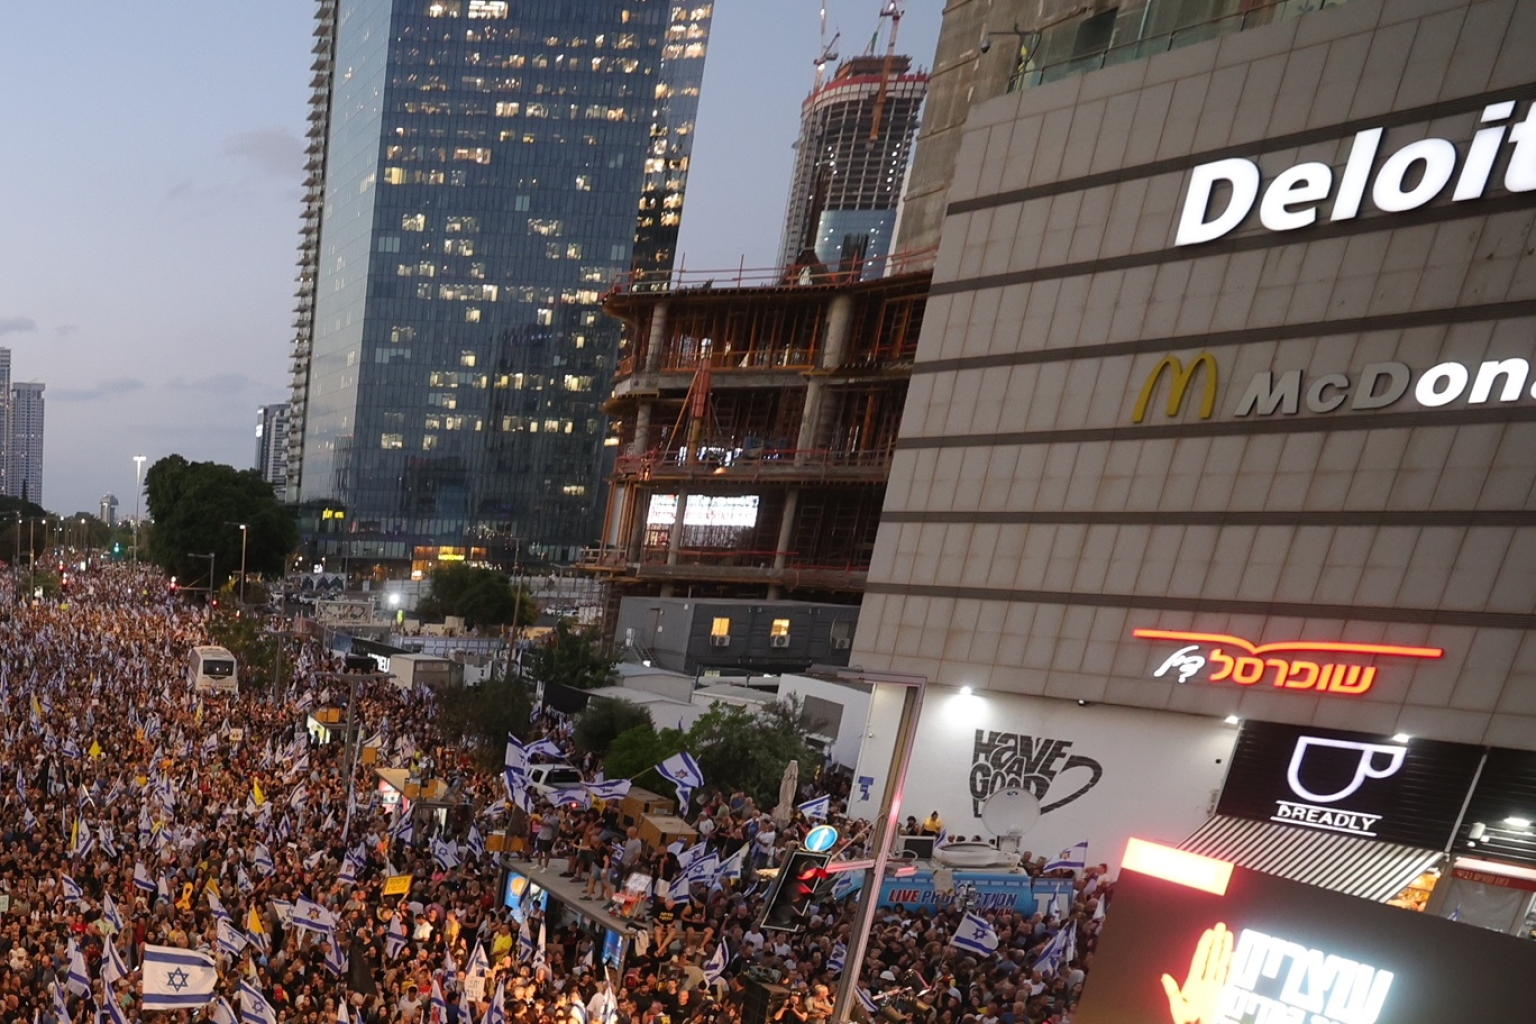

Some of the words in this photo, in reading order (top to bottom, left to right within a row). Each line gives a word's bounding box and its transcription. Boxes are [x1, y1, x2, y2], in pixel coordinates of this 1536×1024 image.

[1233, 356, 1536, 417] McDon
[1208, 648, 1378, 695] שופרסל
[1277, 804, 1377, 832] BREADLY
[888, 889, 921, 903] LIVE
